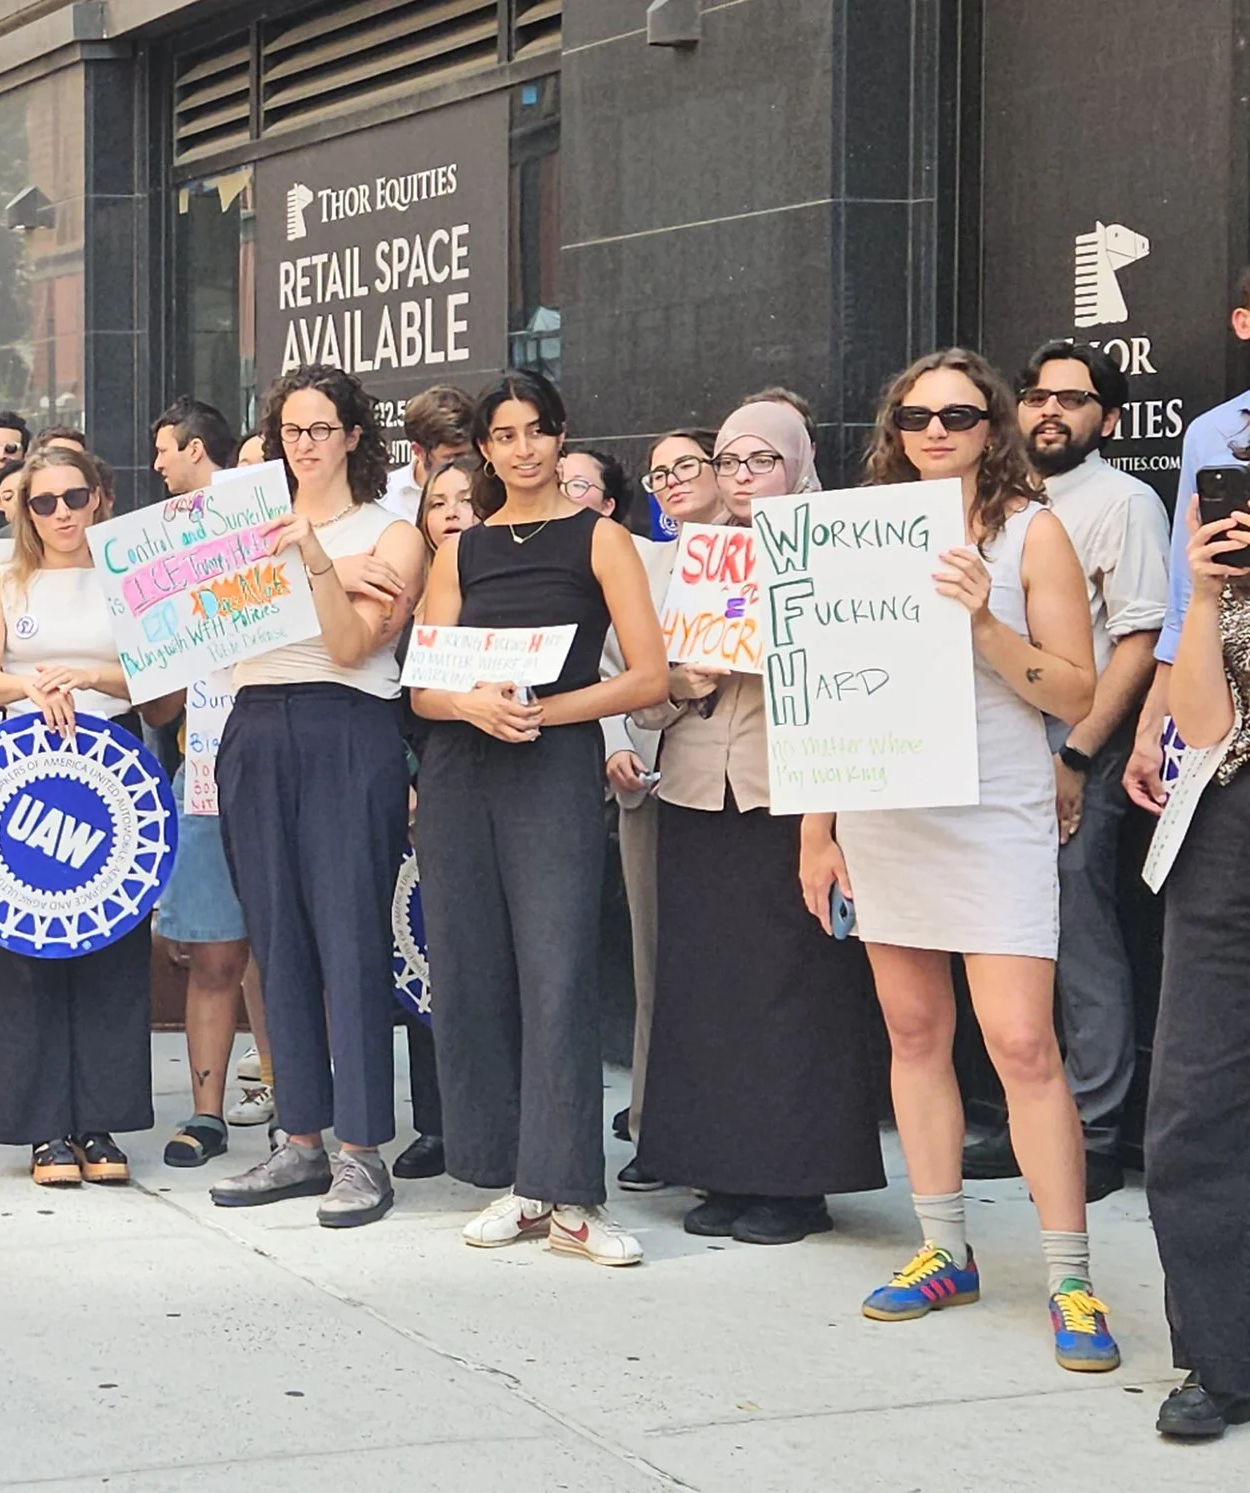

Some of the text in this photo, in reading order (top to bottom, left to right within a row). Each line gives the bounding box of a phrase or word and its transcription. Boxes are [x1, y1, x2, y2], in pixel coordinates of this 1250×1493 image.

[318, 163, 458, 223] THOR EQUITIES
[279, 224, 469, 310] RETAIL SPACE
[281, 292, 469, 377] AVAILABLE
[104, 521, 174, 574] Control
[754, 502, 930, 575] WORKING
[185, 615, 226, 646] WFH
[662, 607, 764, 670] HYPOCRI
[769, 577, 920, 648] FUCKING
[767, 648, 890, 727] HARD
[26, 760, 39, 771] OF
[43, 757, 88, 773] AMERICA
[89, 768, 120, 797] UNITED
[6, 793, 107, 869] UAW
[49, 900, 72, 910] AND
